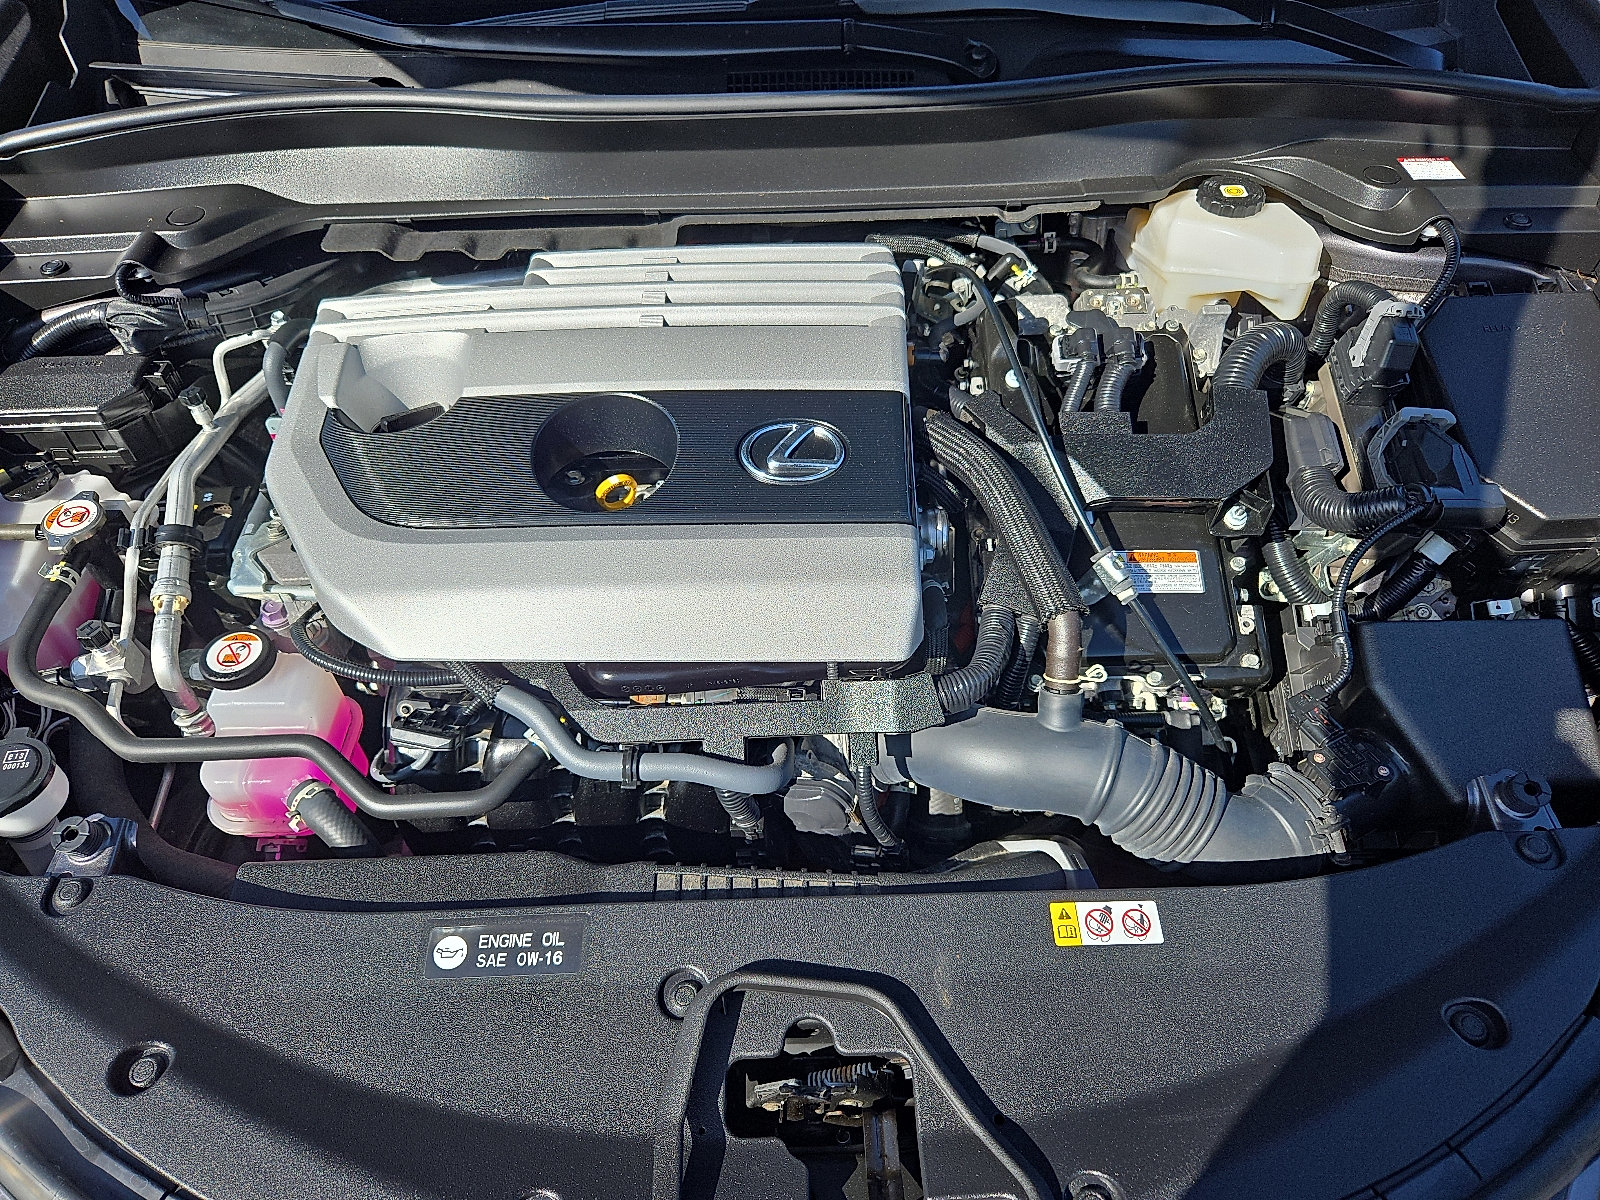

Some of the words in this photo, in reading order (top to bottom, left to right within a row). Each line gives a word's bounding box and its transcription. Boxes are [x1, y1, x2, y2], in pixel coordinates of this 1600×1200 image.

[478, 932, 533, 949] ENGINE
[541, 931, 565, 948] OIL
[475, 952, 508, 968] SAE
[516, 950, 564, 967] 0W-16
